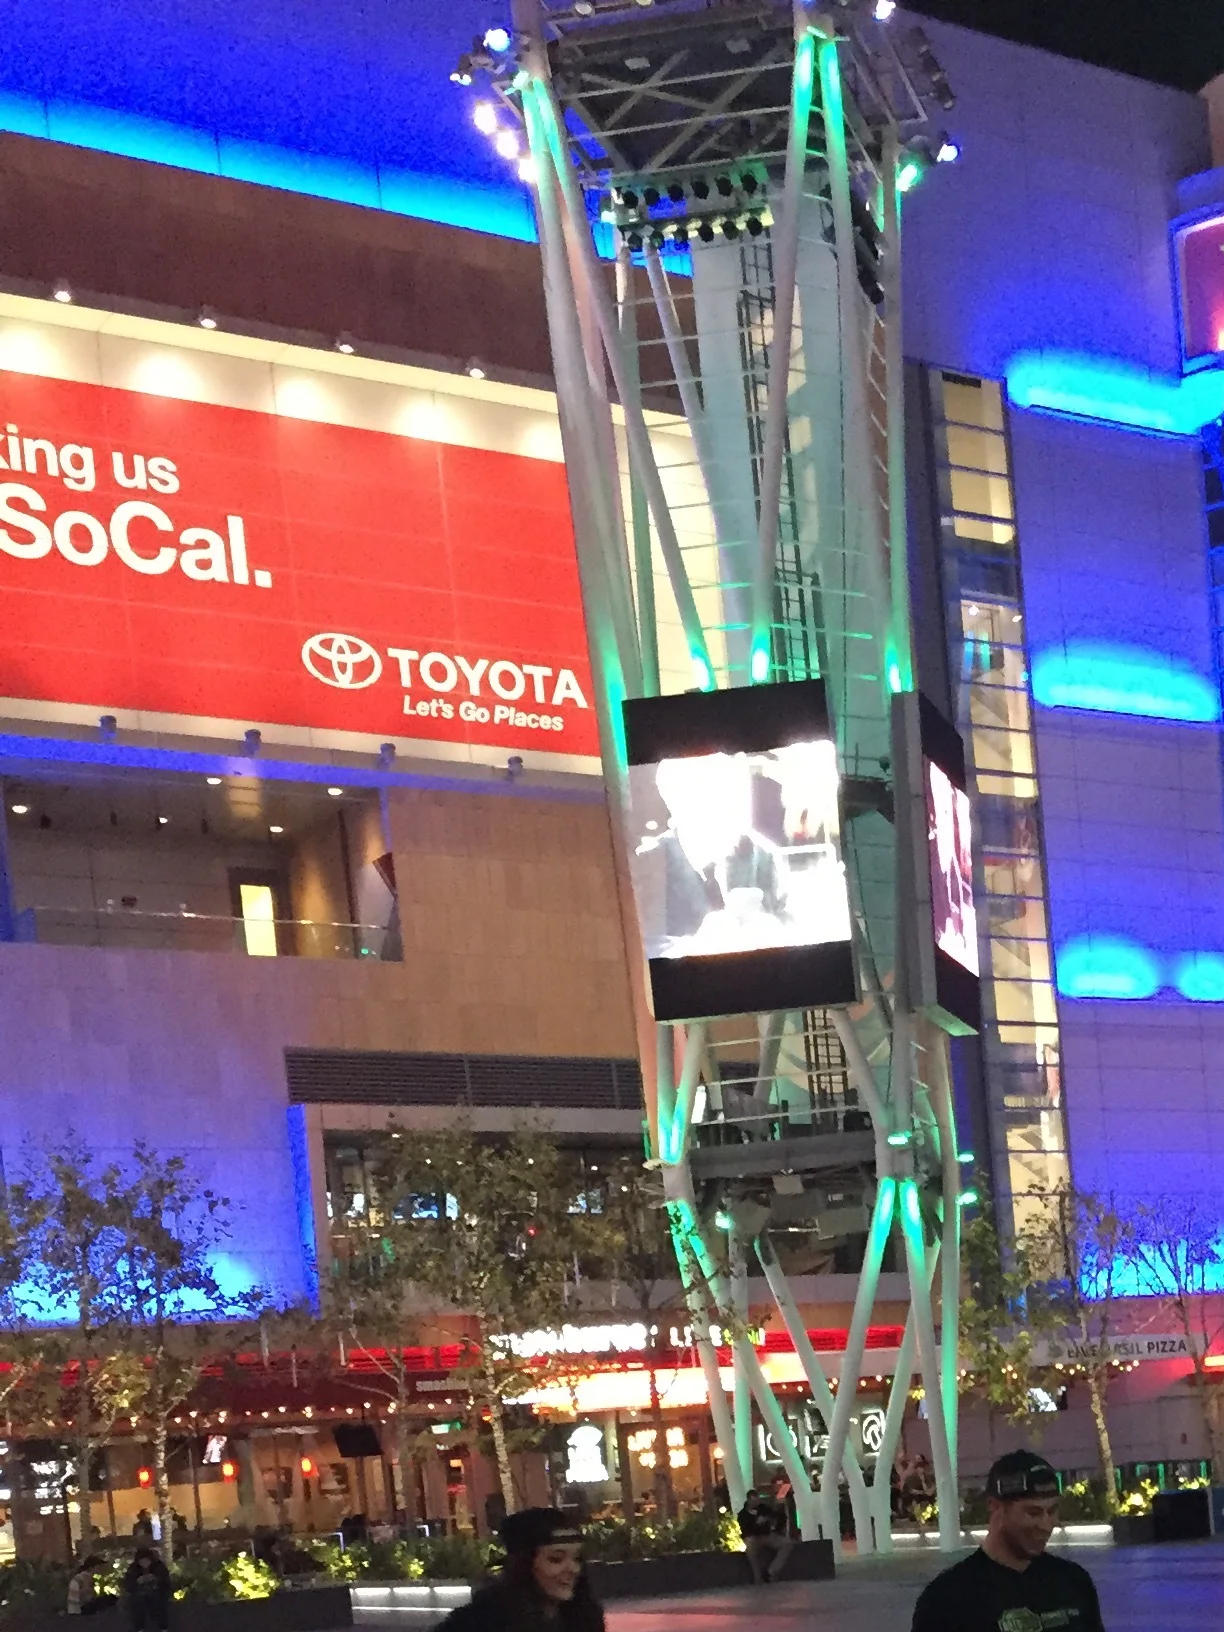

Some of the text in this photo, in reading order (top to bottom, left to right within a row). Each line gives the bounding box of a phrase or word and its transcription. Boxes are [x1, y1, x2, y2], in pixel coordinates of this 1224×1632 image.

[112, 451, 180, 494] us
[0, 482, 273, 588] SoCal.
[387, 648, 589, 709] TOYOTA
[403, 695, 564, 731] Let's Go Places
[1147, 1340, 1187, 1353] PIZZA
